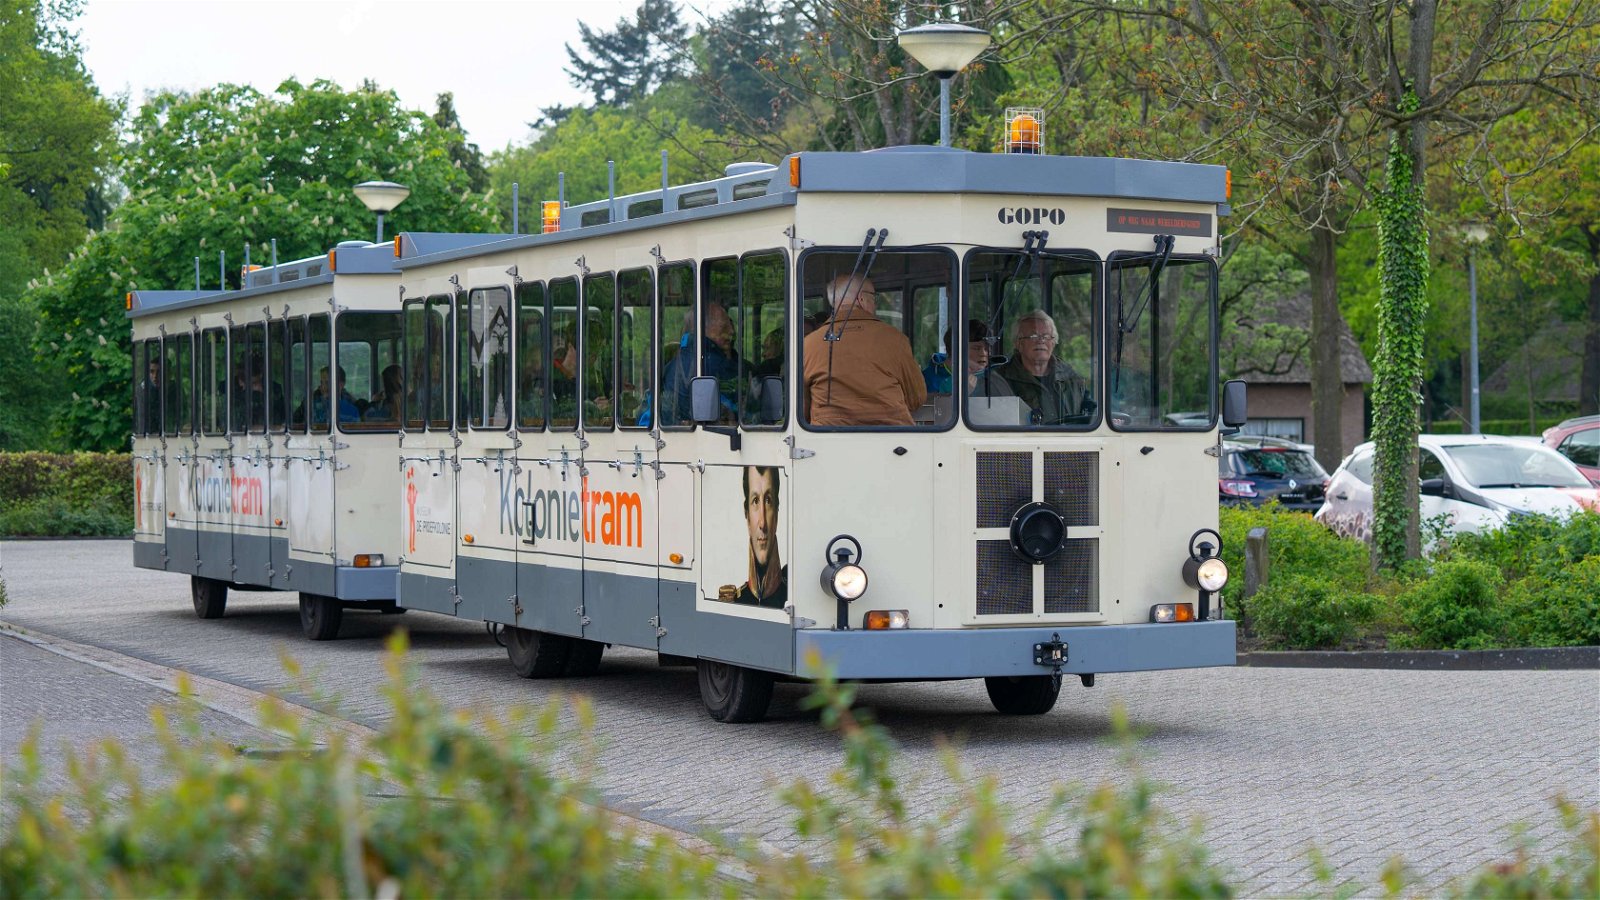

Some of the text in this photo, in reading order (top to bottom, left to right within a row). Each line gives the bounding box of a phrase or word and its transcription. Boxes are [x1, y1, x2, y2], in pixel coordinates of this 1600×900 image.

[998, 207, 1066, 226] GOPO
[187, 464, 262, 516] Kolonietram
[499, 468, 643, 548] Kolonietram
